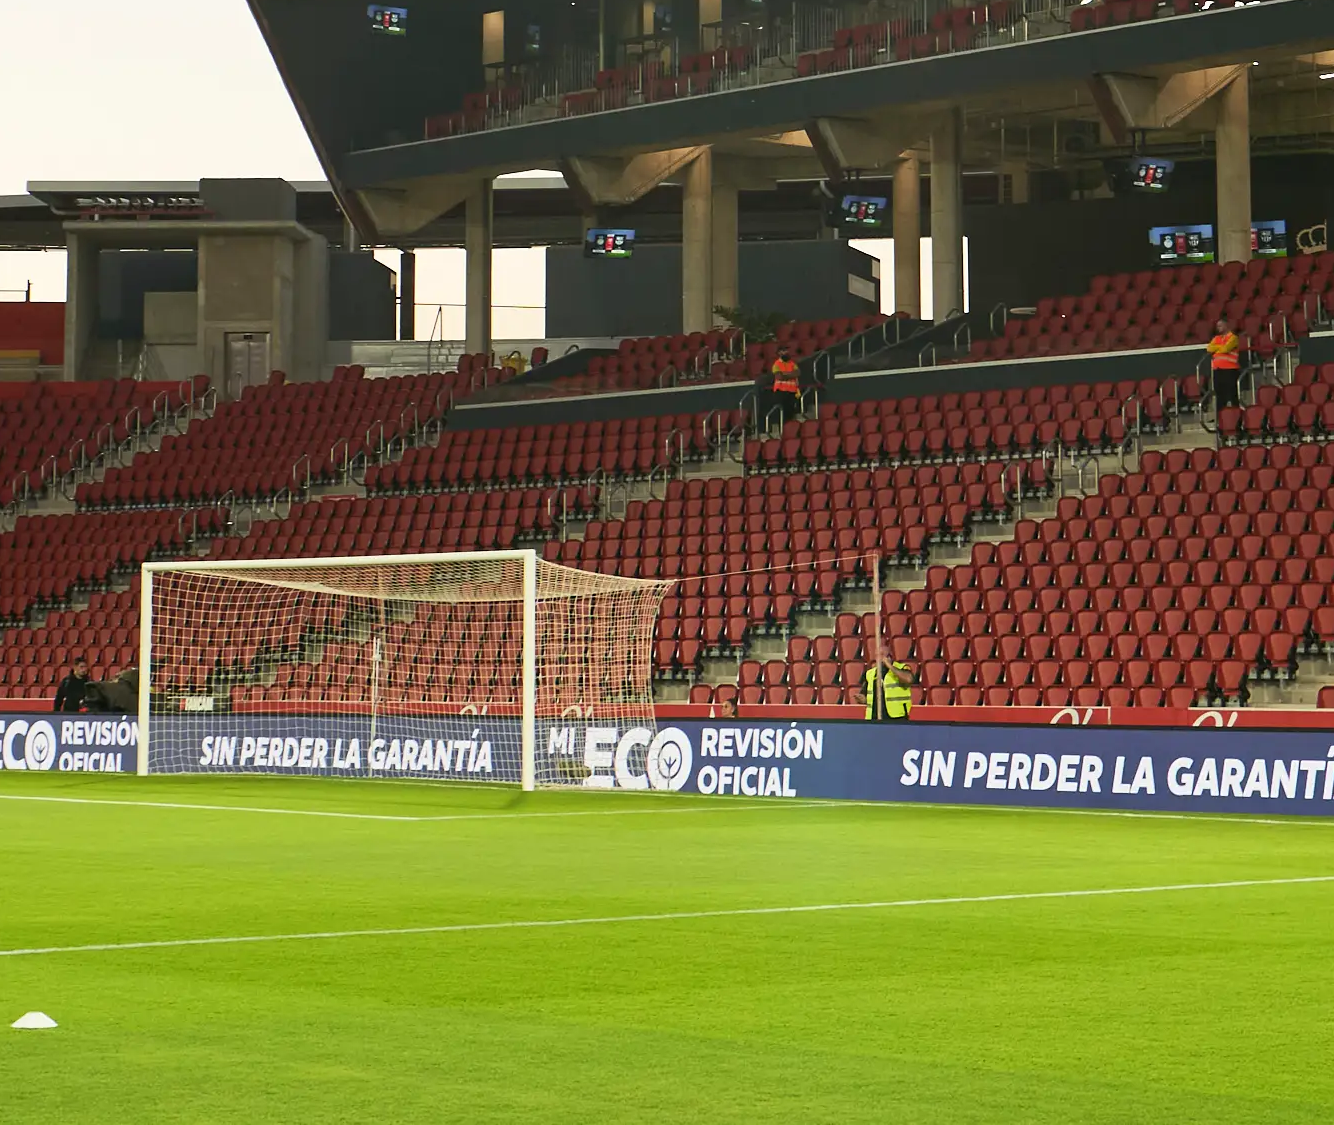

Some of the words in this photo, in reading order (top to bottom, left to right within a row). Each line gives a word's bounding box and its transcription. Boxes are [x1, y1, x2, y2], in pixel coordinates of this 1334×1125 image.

[59, 751, 125, 772] OFICIAL
[199, 735, 236, 766] SIN
[239, 735, 328, 768] PERDER
[332, 738, 361, 769] LA
[368, 728, 493, 773] GARANTÍA
[548, 726, 575, 755] MI
[582, 726, 693, 792] ECO
[700, 722, 823, 760] REVISIÓN
[697, 766, 797, 797] OFICIAL
[899, 748, 956, 787] SIN
[963, 751, 1103, 793] PERDER
[1112, 755, 1156, 795] LA
